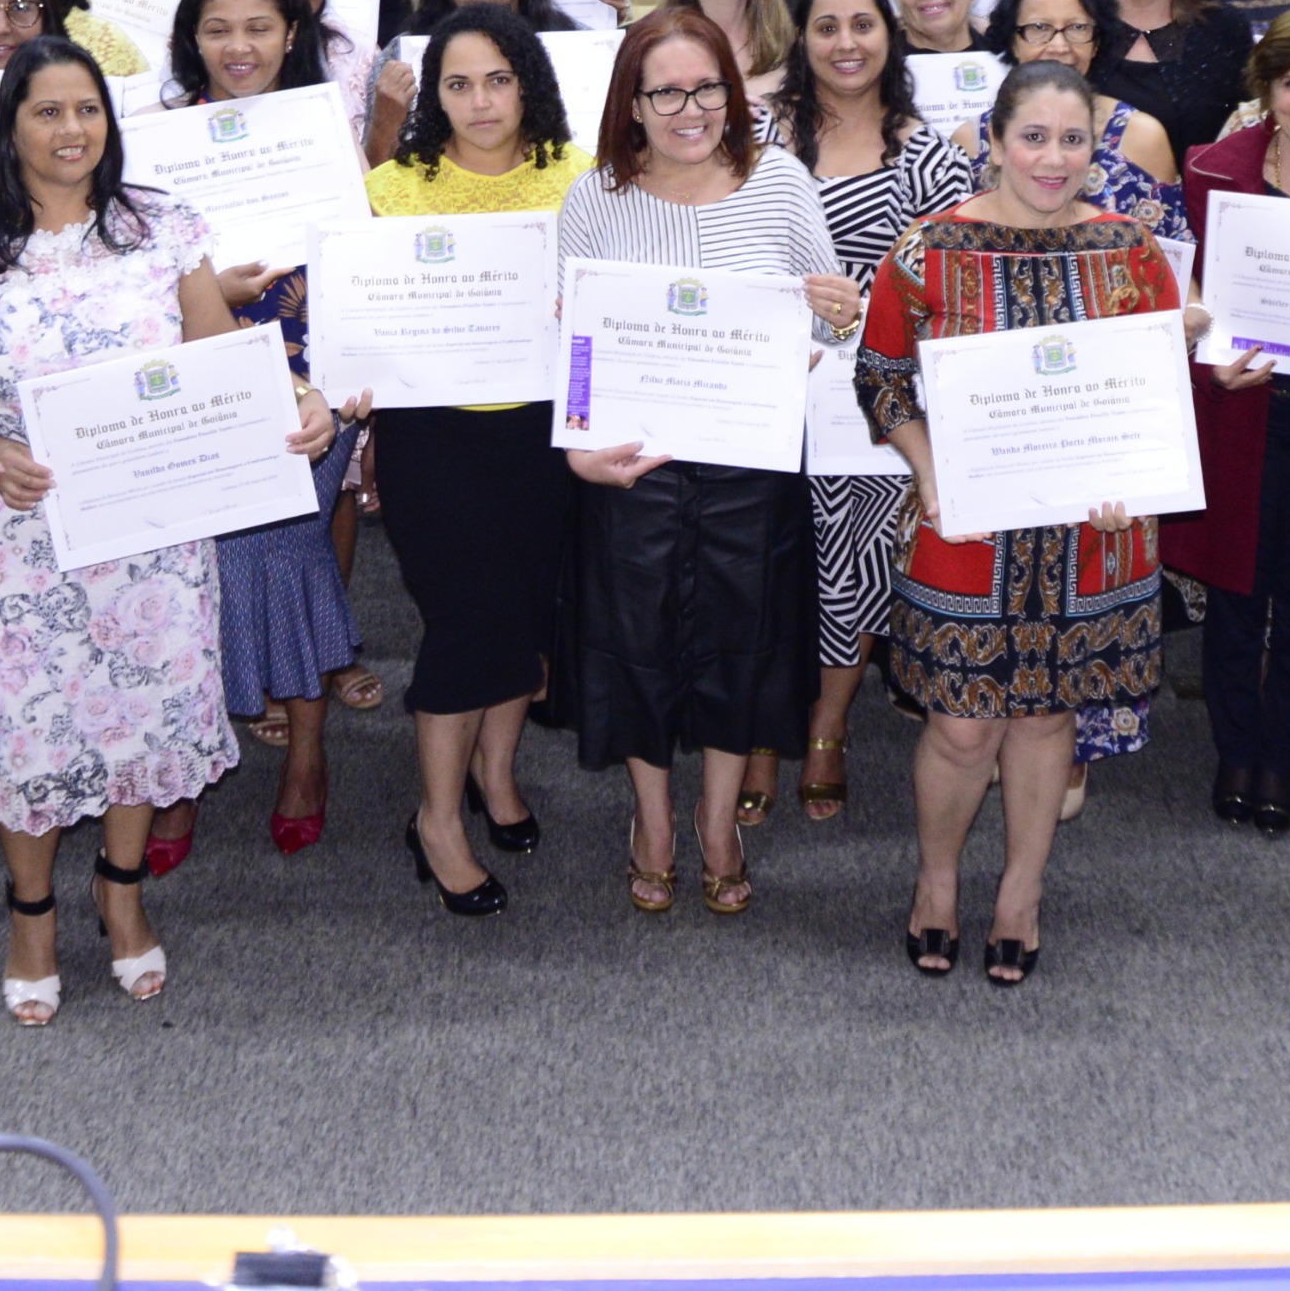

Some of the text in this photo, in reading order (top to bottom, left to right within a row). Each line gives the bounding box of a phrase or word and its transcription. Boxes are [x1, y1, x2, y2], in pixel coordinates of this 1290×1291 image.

[1245, 246, 1290, 263] Diploma
[351, 271, 519, 288] Diploma de Honra ao Mérito
[368, 288, 503, 302] Câmara Municipal de Goiânia
[603, 317, 770, 343] Diploma de Honra ao Mérito
[618, 336, 752, 357] Câmara Municipal de Goiânia
[970, 377, 1146, 406] Diploma de Honra ao Mérito
[74, 391, 252, 440] Diploma de Honra ao Mérito
[989, 396, 1130, 420] Câmara Municipal de Goiânia
[96, 411, 238, 451] Câmara Municipal de Goiânia
